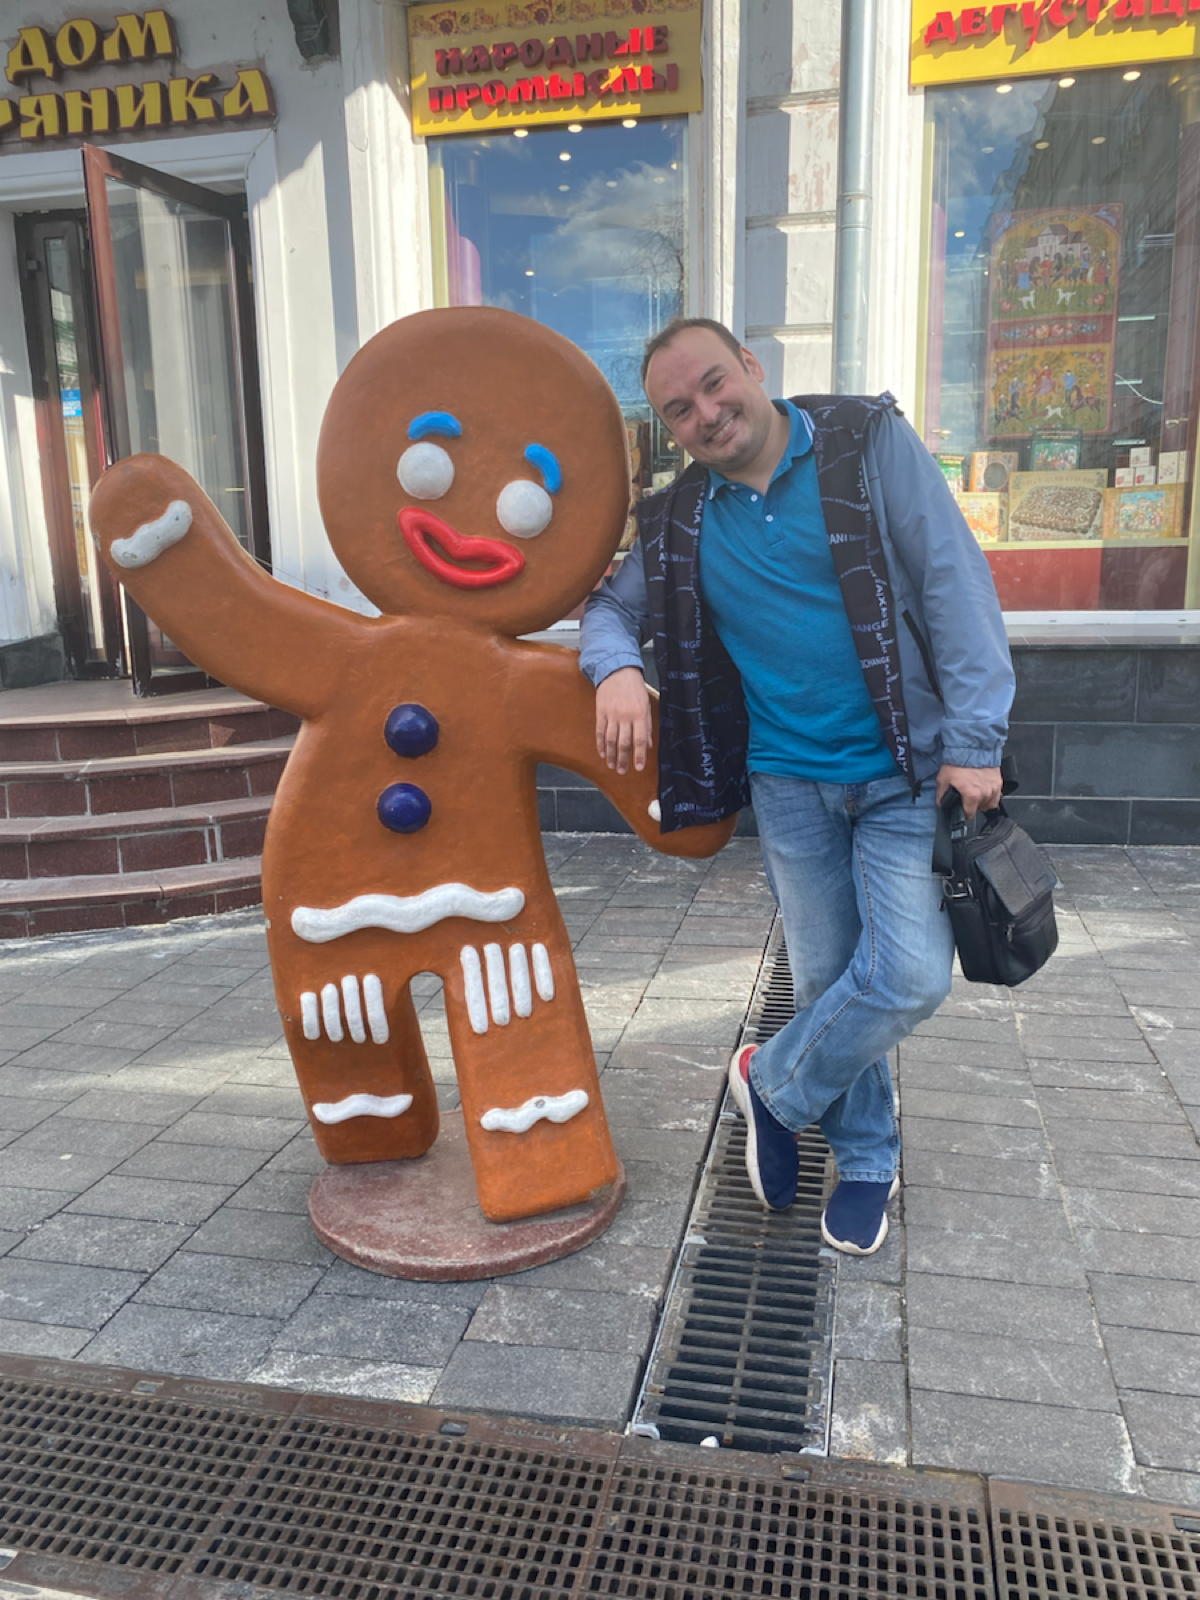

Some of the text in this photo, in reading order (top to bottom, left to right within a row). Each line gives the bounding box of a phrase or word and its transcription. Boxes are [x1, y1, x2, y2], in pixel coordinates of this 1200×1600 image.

[4, 9, 176, 84] ДОМ
[924, 0, 1200, 49] ДЕГУСТАЦ
[435, 25, 669, 76] НАРОДНЫЕ
[0, 68, 275, 141] ЯНИКА
[428, 63, 679, 112] ПРОМЫСЛЫ
